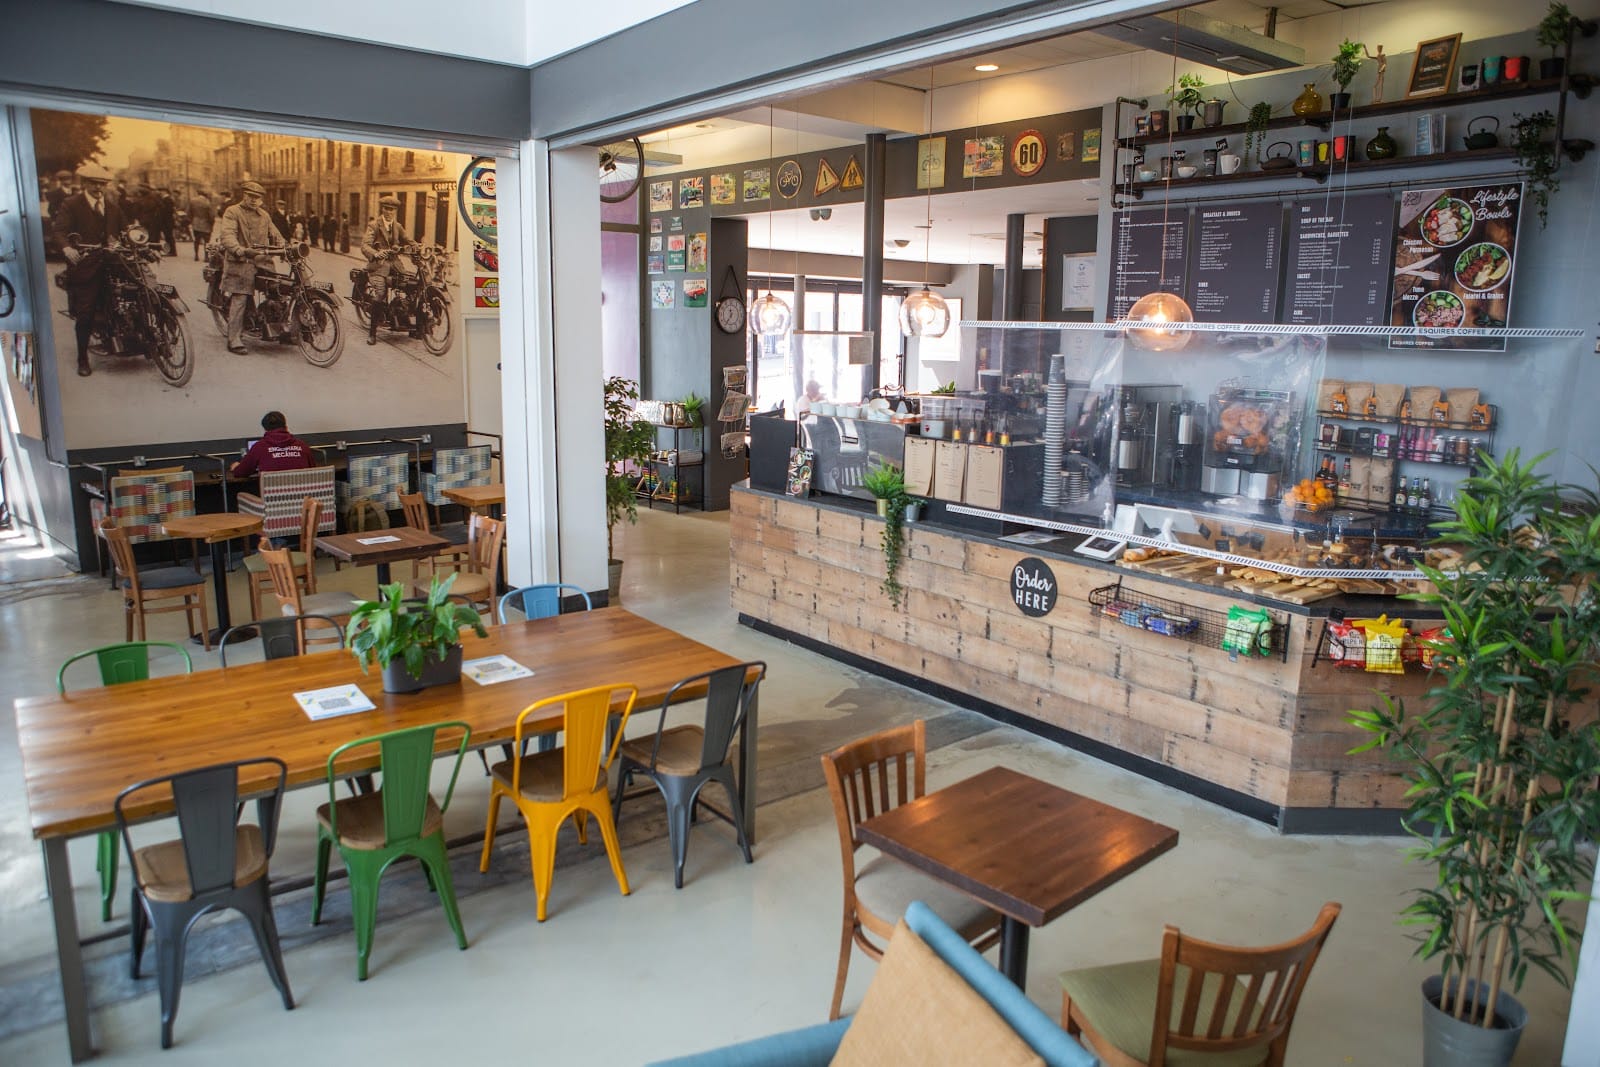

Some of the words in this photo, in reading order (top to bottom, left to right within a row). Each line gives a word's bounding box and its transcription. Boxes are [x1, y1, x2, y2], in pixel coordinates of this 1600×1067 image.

[1019, 142, 1038, 165] 60
[1470, 187, 1520, 207] Lifestyle
[1476, 206, 1512, 220] Bowls
[1015, 566, 1053, 591] Order
[1016, 589, 1048, 611] HERE
